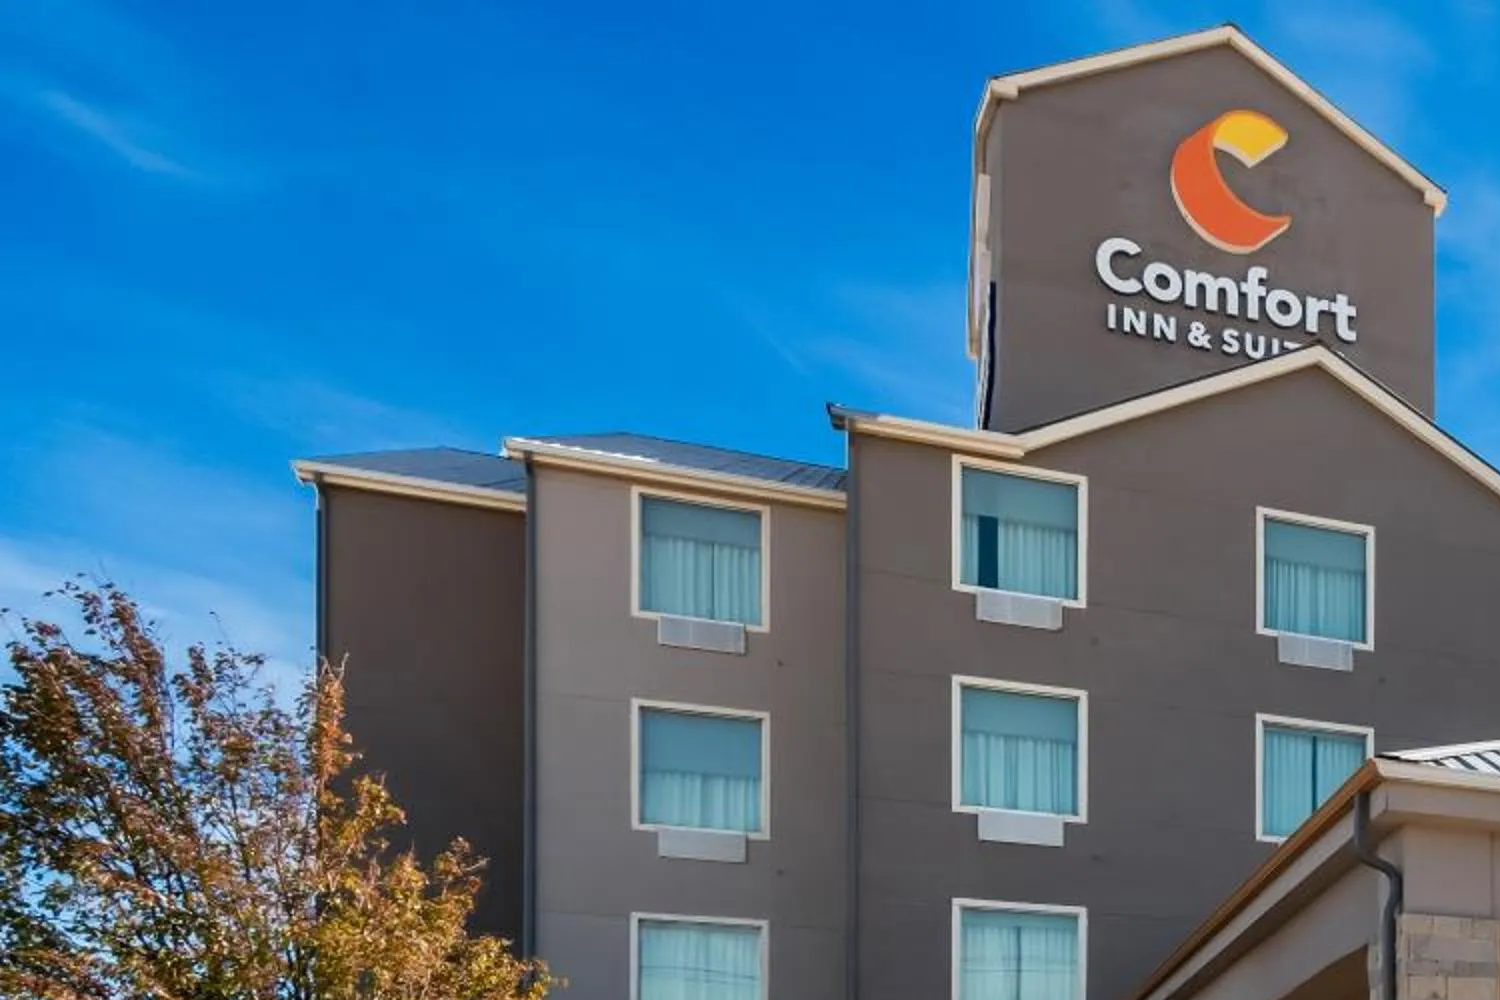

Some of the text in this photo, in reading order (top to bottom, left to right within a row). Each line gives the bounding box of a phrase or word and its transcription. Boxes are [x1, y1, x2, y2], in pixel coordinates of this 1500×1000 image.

[1095, 237, 1358, 342] Comfort
[1106, 303, 1303, 360] INN & SUI
